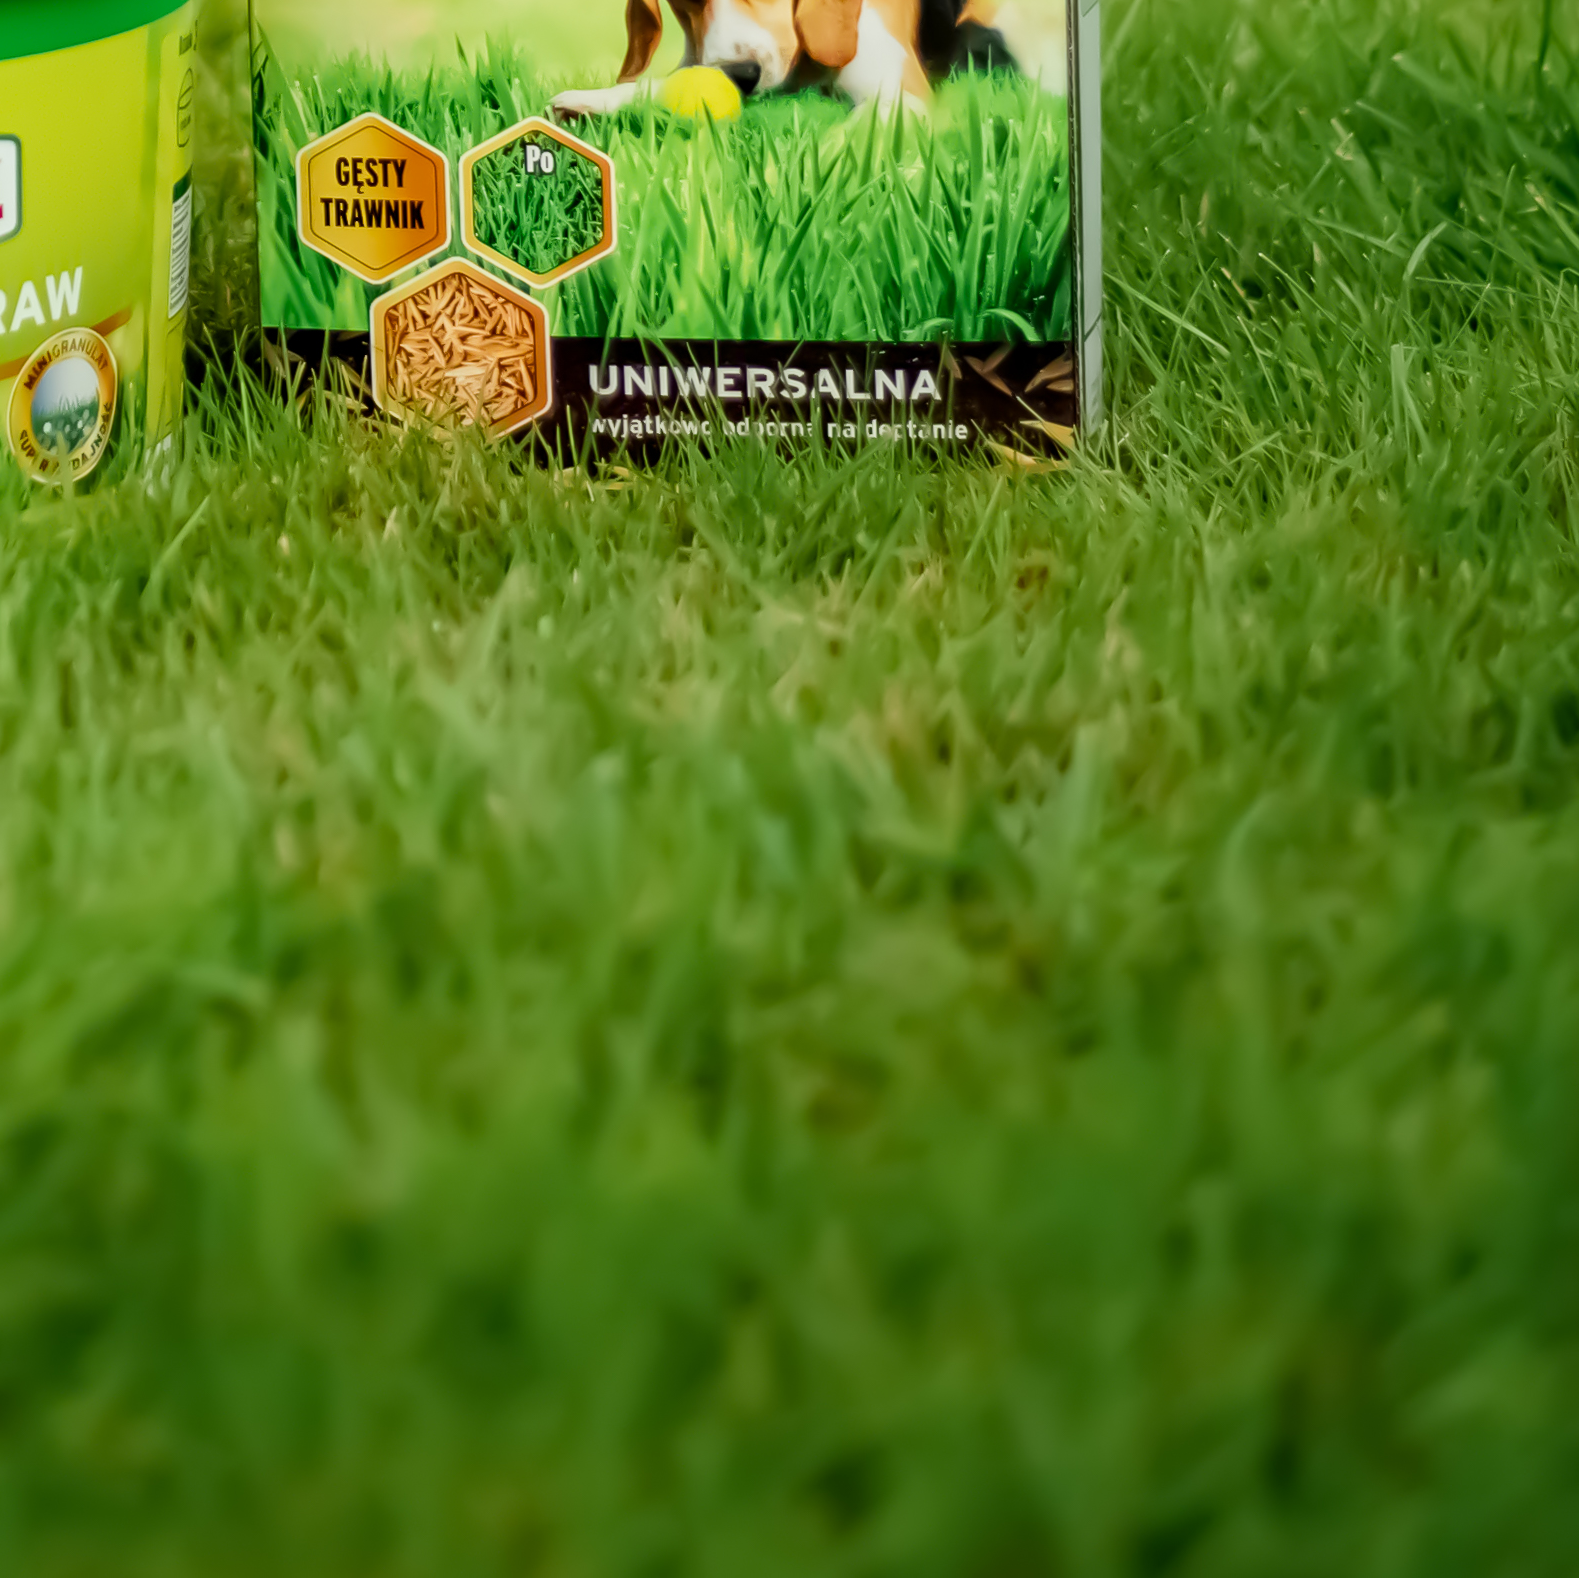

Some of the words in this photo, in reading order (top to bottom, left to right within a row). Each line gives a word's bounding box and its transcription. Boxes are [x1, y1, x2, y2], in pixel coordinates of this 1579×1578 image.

[335, 156, 408, 195] GĘSTY
[524, 143, 556, 176] Po
[319, 197, 426, 230] TRAWNIK
[23, 337, 109, 391] MINIGRANULAT
[588, 364, 943, 401] UNIWERSALNA
[826, 422, 856, 439] na
[19, 429, 50, 473] SUPR
